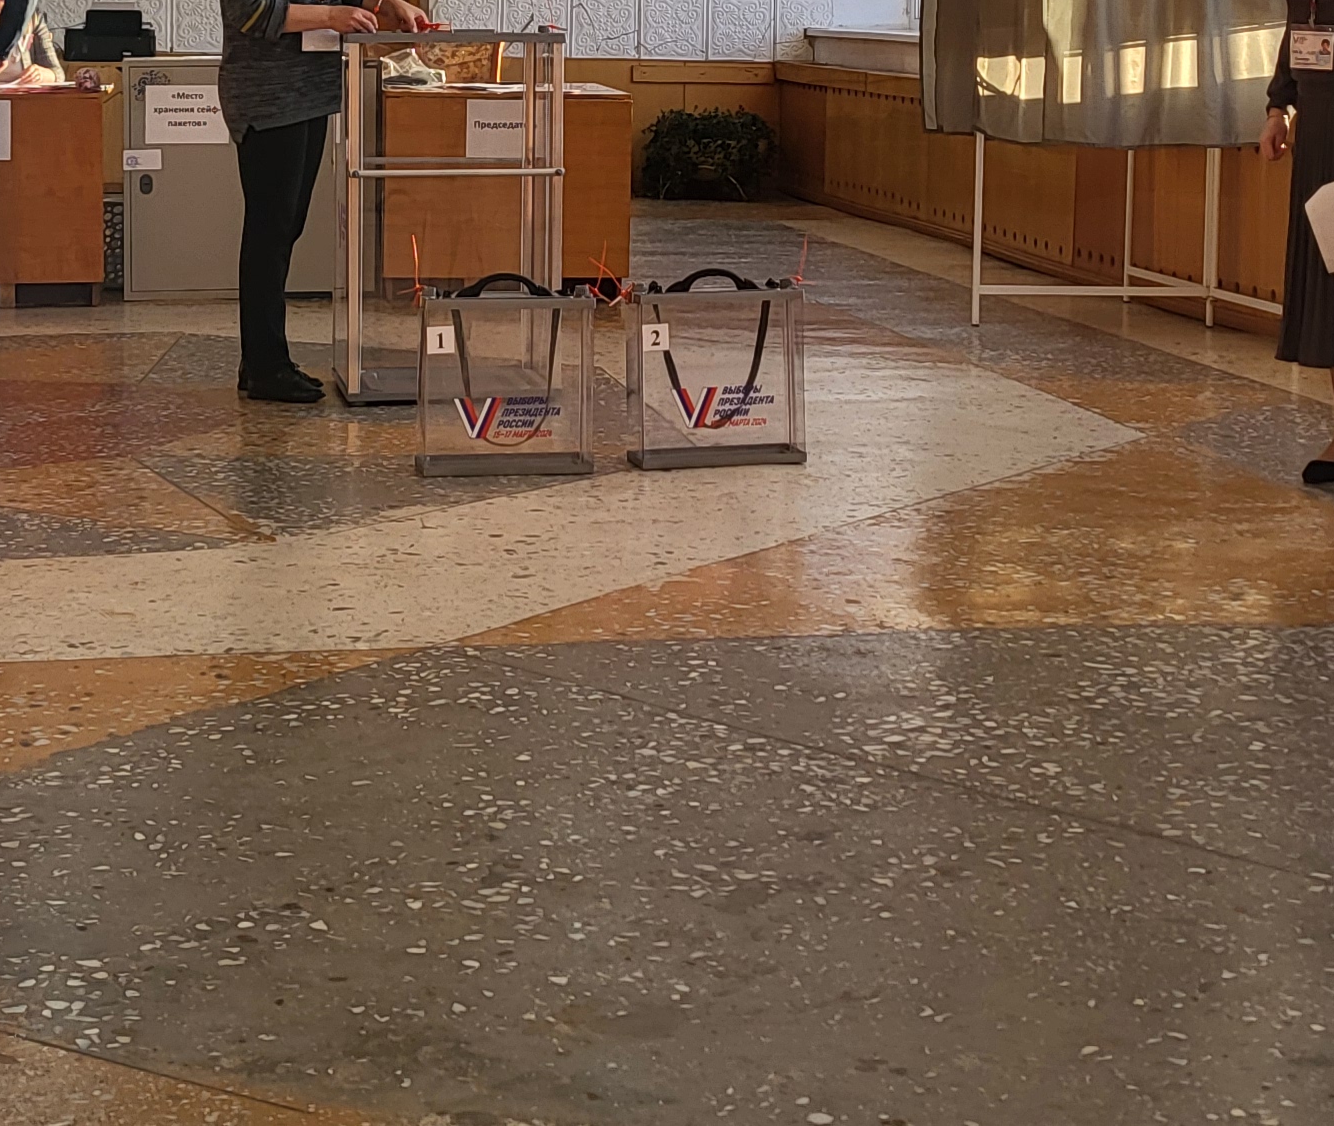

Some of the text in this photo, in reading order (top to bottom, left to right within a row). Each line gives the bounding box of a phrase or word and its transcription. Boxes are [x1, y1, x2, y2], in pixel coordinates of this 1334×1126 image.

[153, 106, 195, 115] хранения
[473, 120, 537, 130] Председат
[436, 331, 445, 349] 1
[650, 329, 661, 347] 2
[722, 384, 762, 395] ВЫБЫ
[507, 396, 548, 406] ВЫБОРЫ
[501, 406, 561, 418] ПРЕЗИДЕНТА
[713, 407, 750, 418] РОСИИ
[497, 419, 535, 429] РОССИИ
